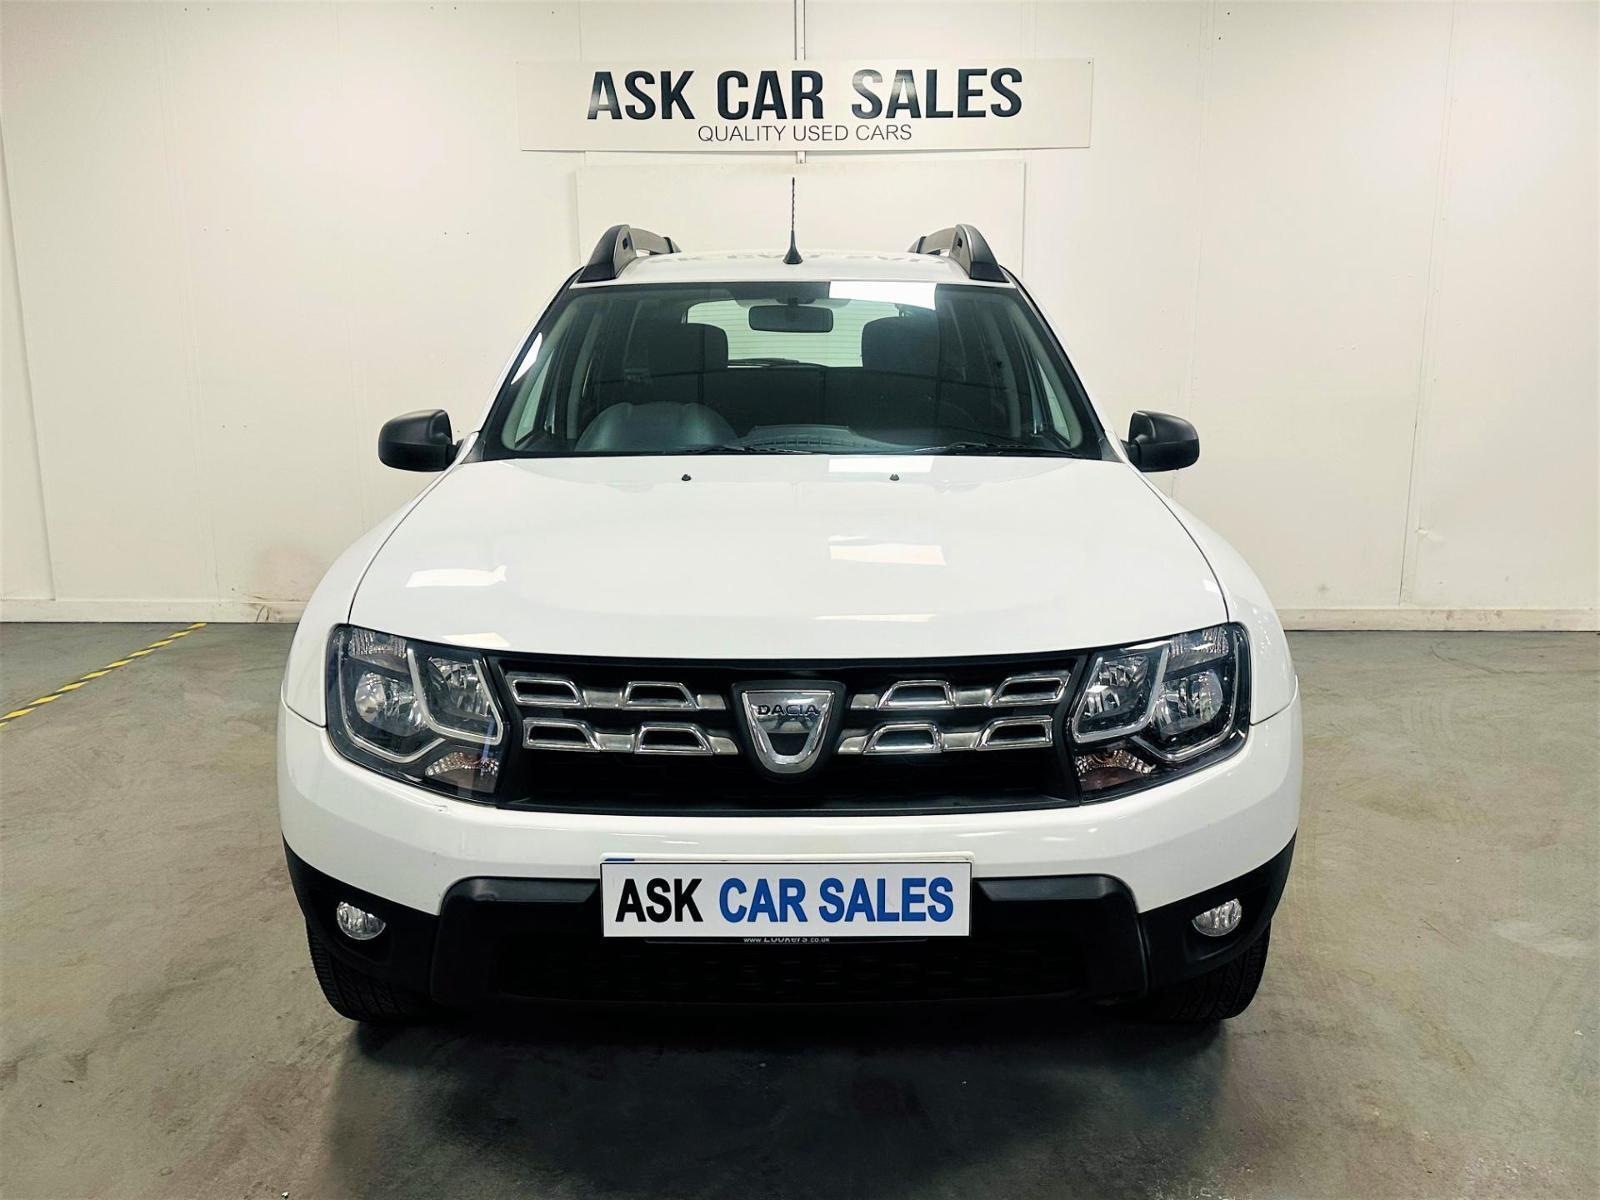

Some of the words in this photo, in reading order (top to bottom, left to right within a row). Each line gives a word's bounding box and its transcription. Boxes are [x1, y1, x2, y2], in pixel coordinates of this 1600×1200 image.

[587, 70, 696, 120] ASK
[717, 70, 825, 121] CAR
[851, 67, 1023, 120] SALES
[698, 125, 787, 142] QUALITY
[793, 124, 849, 142] USED
[855, 123, 912, 141] CARS
[757, 704, 820, 716] DACIA
[615, 877, 704, 923] ASK
[719, 877, 808, 924] CAR
[818, 876, 954, 923] SALES
